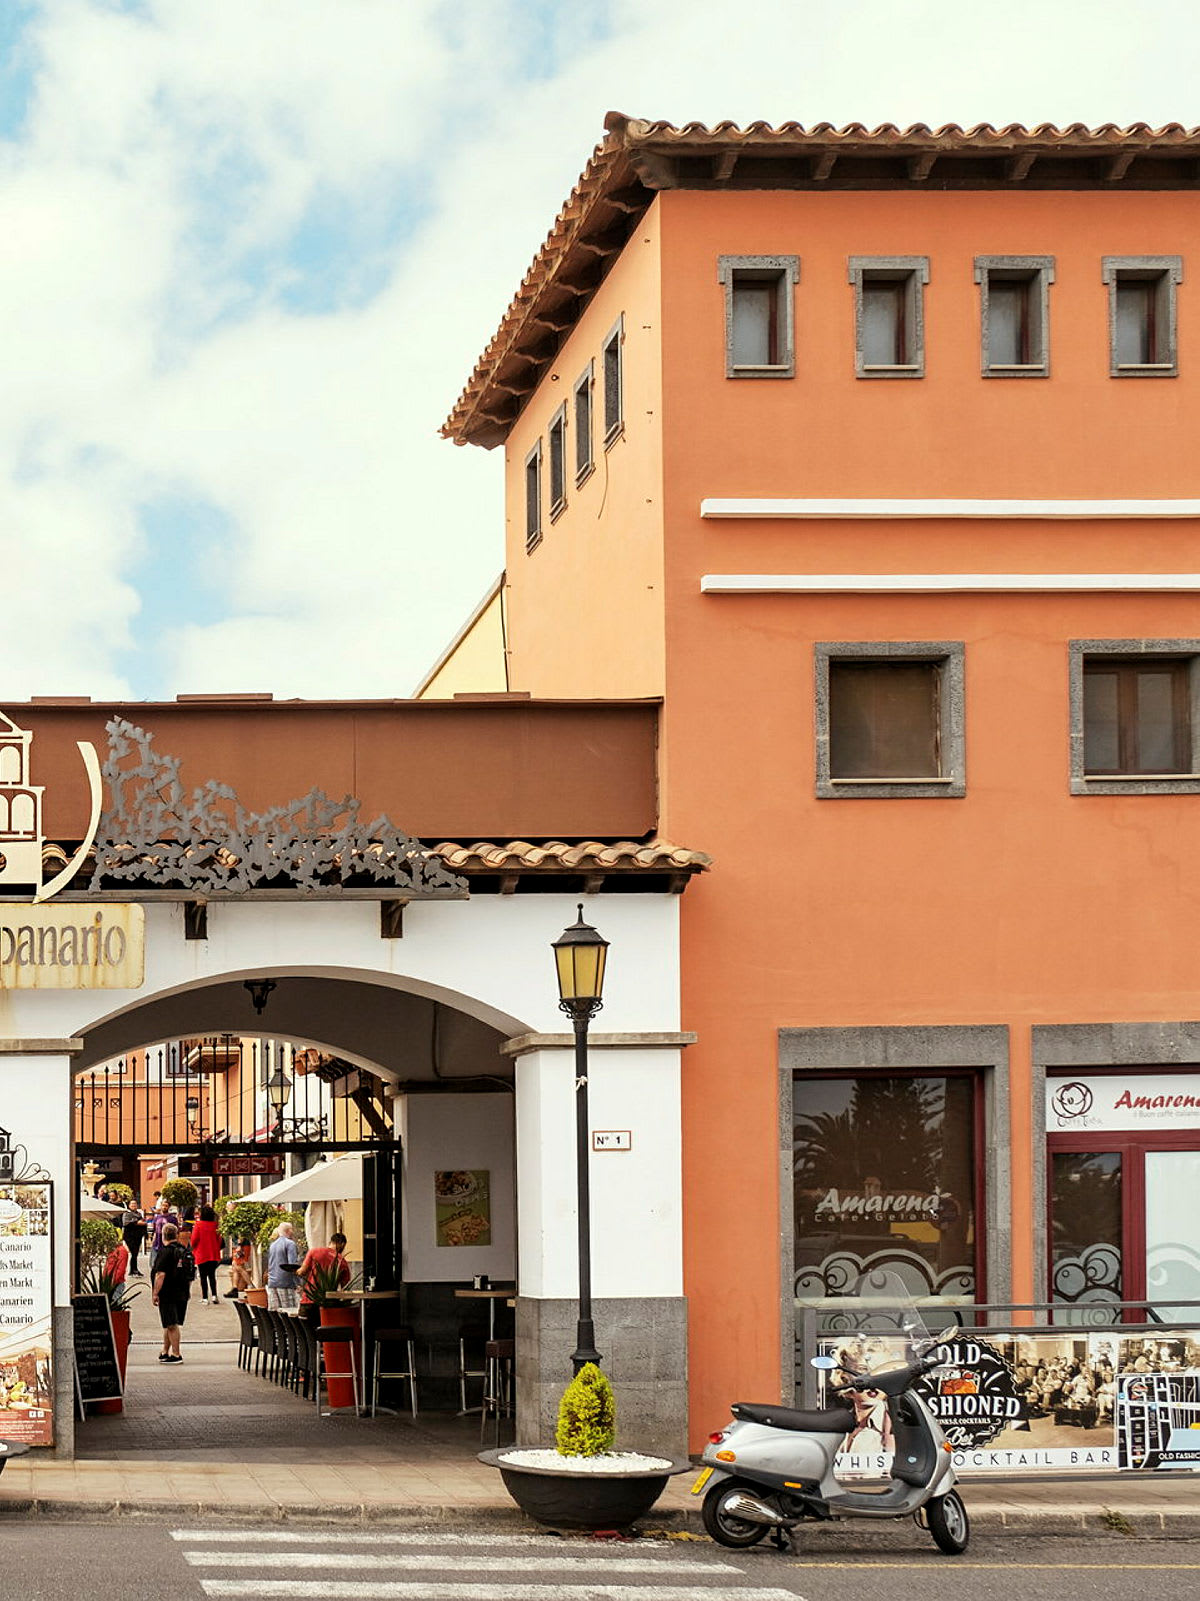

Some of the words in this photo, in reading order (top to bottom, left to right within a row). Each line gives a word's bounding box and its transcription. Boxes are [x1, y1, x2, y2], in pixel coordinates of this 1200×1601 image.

[615, 1136, 621, 1144] 1
[272, 1157, 280, 1171] 1
[815, 1187, 940, 1214] Amarena
[0, 1241, 32, 1252] Canario
[9, 1260, 33, 1270] Market
[10, 1277, 33, 1288] Markt
[0, 1313, 34, 1325] Canario
[937, 1343, 981, 1365] OLD
[927, 1395, 1021, 1418] SHIONED
[945, 1426, 974, 1446] Bar
[952, 1452, 1052, 1467] OCKTAIL
[1070, 1450, 1111, 1464] BAR
[1159, 1452, 1174, 1460] OLD
